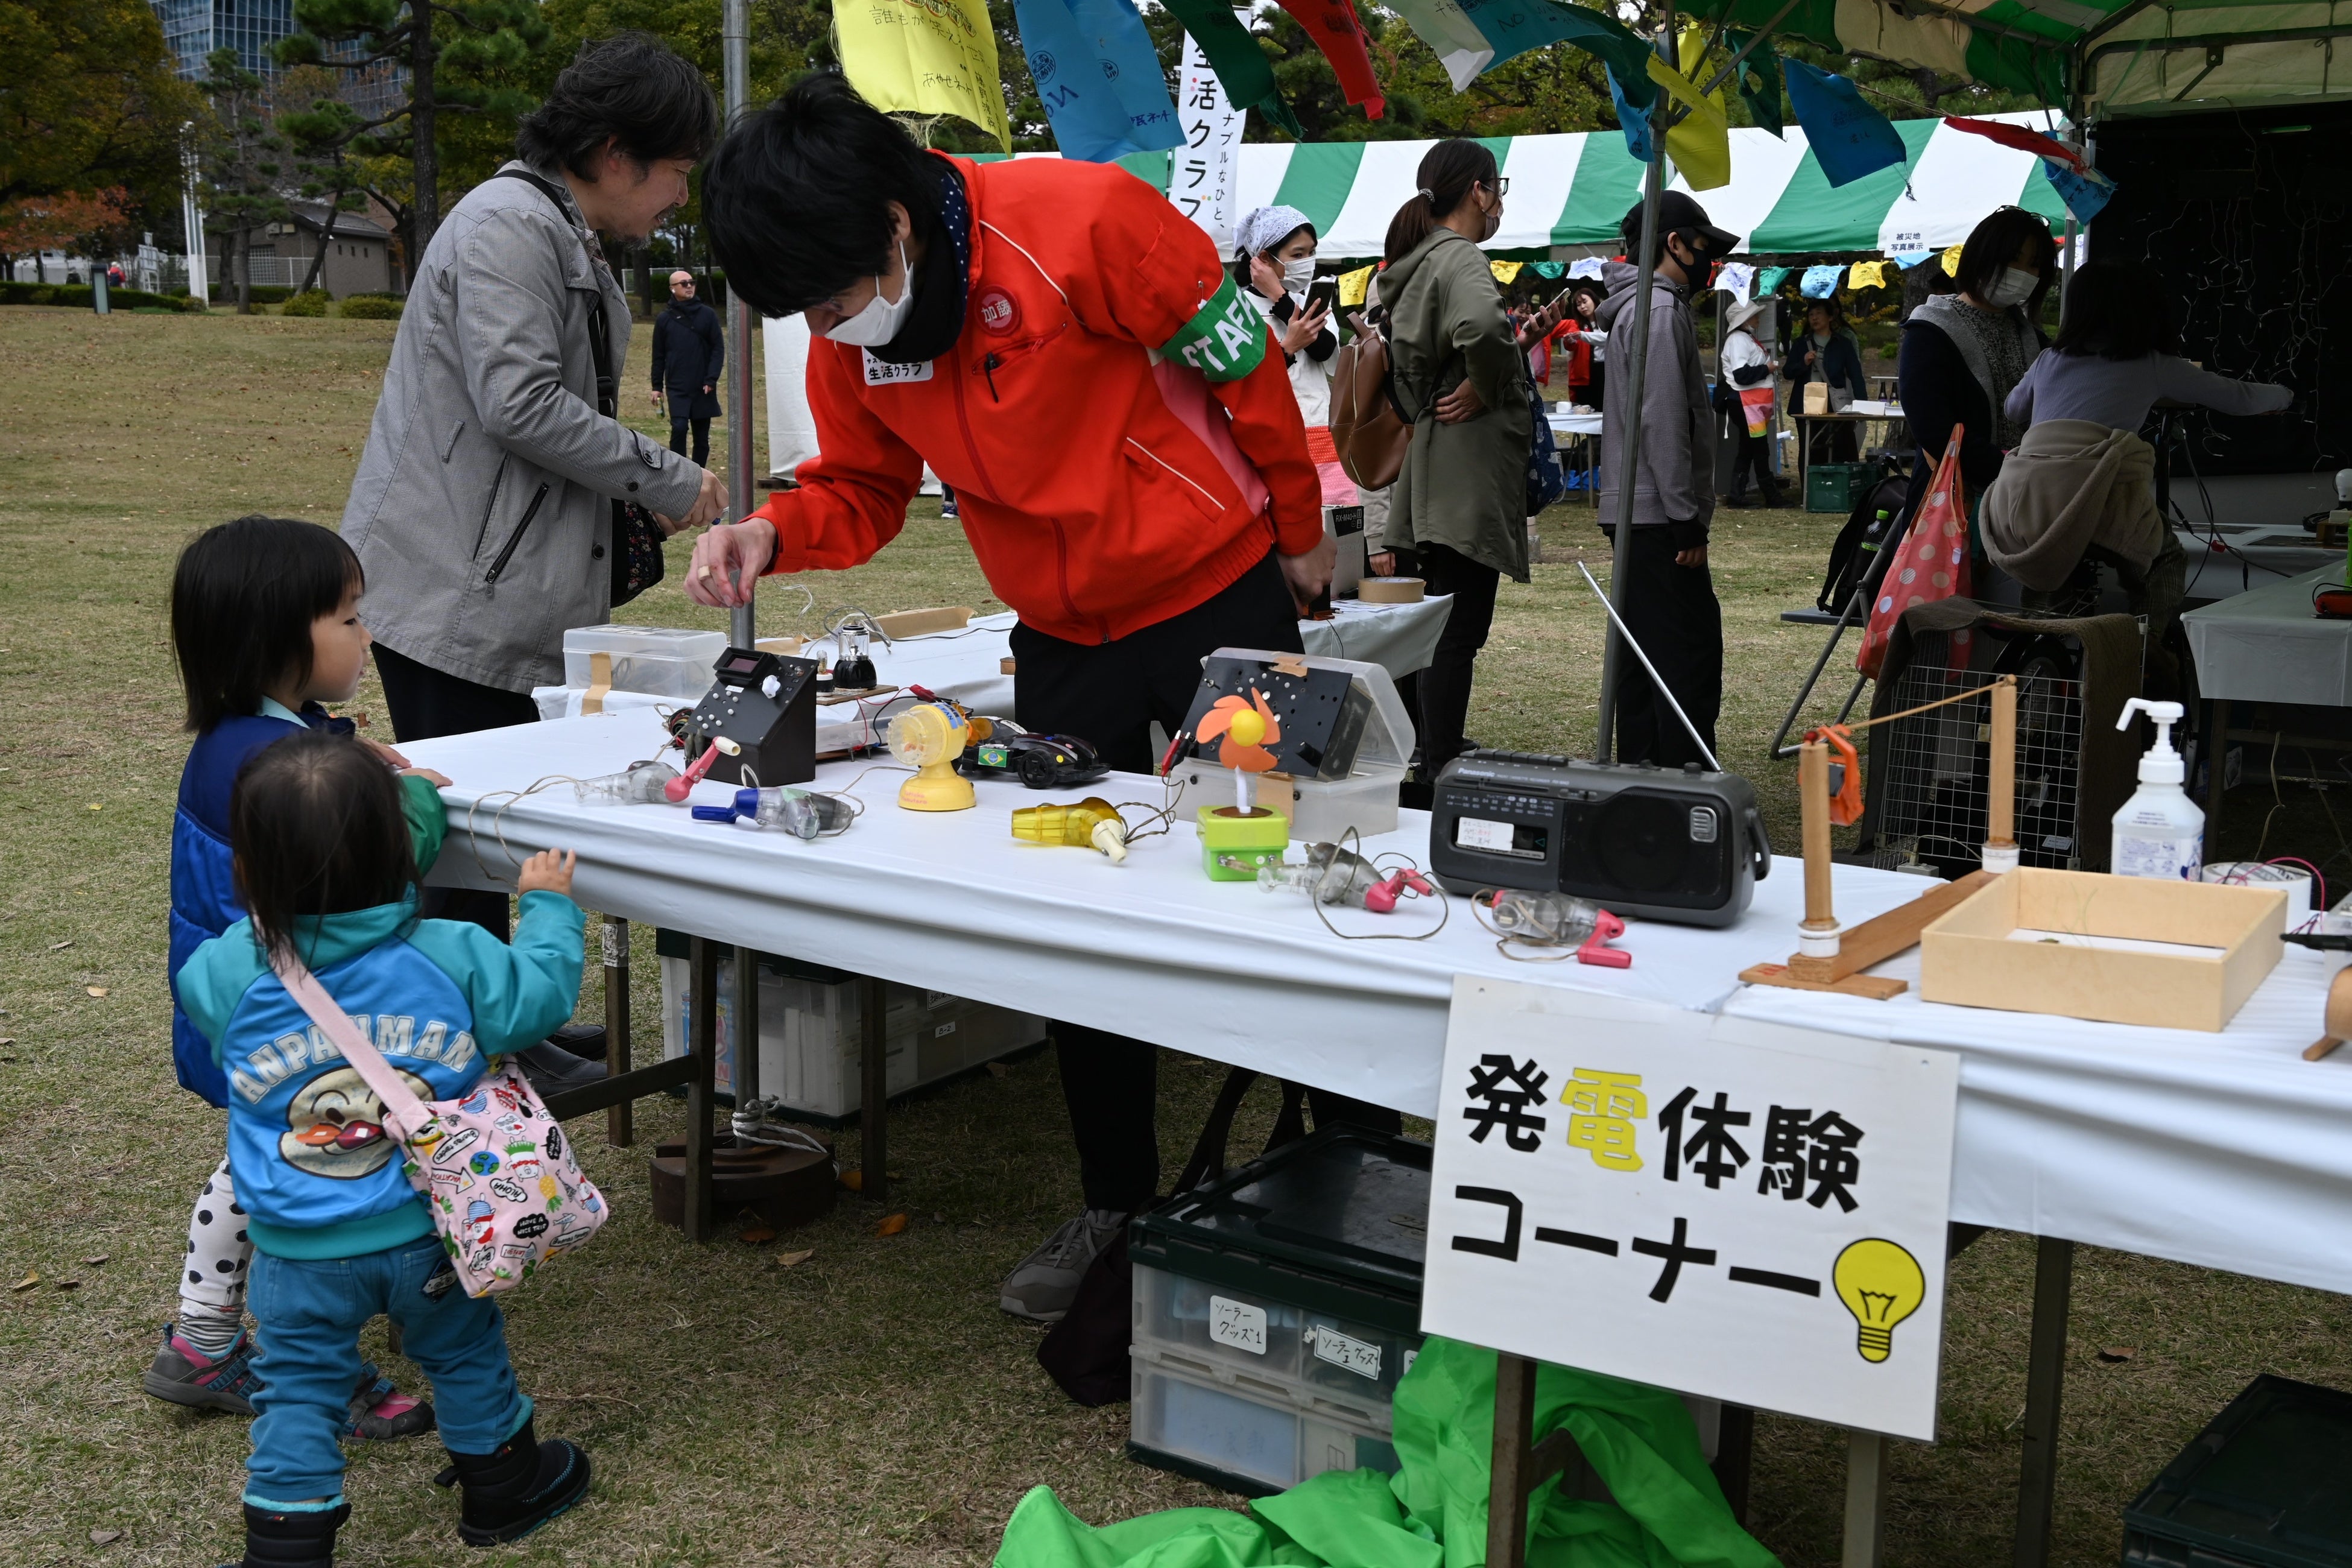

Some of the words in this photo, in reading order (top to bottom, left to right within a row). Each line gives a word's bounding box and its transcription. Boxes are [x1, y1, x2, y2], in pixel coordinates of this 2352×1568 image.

[1896, 232, 1921, 241] 被災地
[1891, 242, 1924, 251] 写真展示
[981, 299, 1013, 323] 加藤
[1458, 767, 1496, 777] Panasonic
[939, 1025, 951, 1034] B-2
[1462, 1053, 1866, 1214] 発電体験
[494, 1181, 522, 1198] ALOHA
[1451, 1184, 1821, 1304] コーナー
[1215, 1304, 1251, 1321] ソーラー
[1219, 1321, 1262, 1344] グッズ1
[1323, 1336, 1350, 1355] ソーラー
[1342, 1355, 1350, 1364] 1
